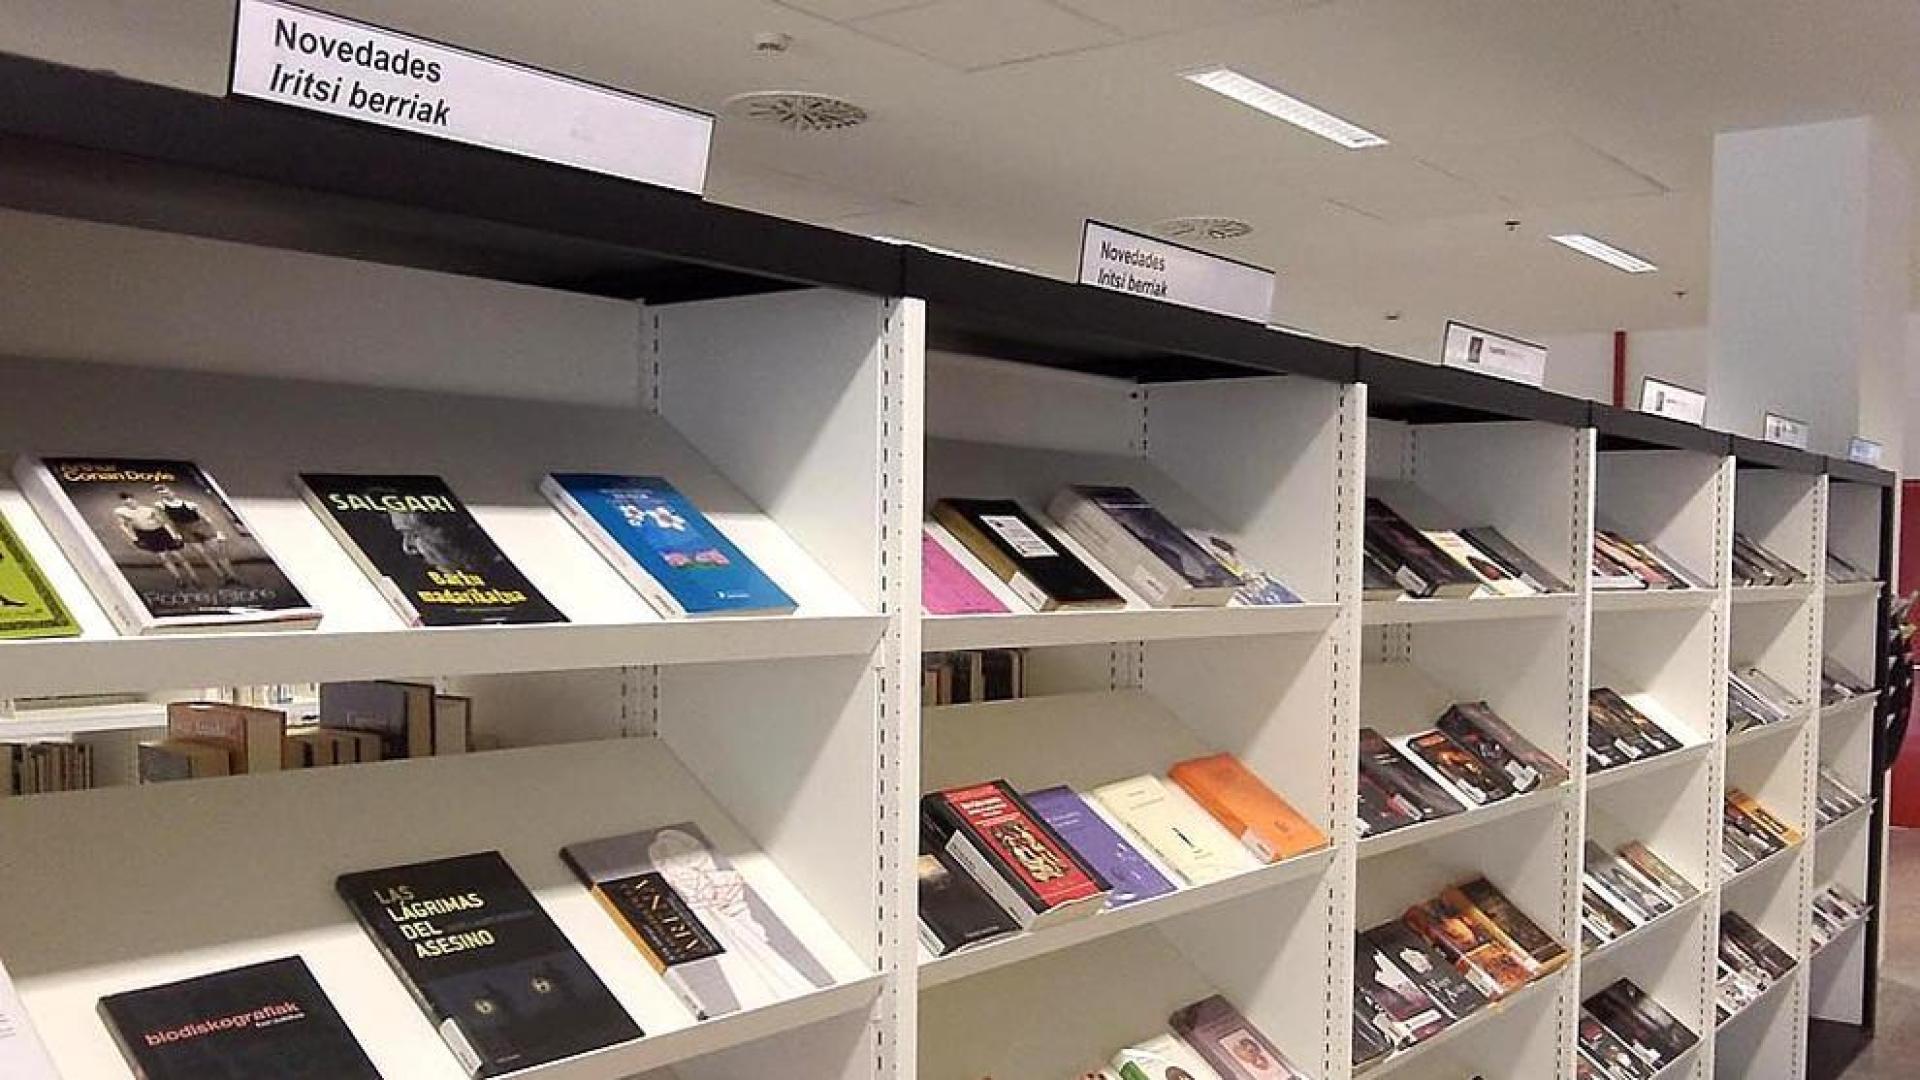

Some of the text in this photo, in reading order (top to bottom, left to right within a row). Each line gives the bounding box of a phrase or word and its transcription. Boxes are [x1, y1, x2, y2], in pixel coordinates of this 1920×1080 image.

[274, 18, 442, 83] Novedades
[269, 63, 451, 127] Iritsi berriak
[1101, 241, 1165, 272] Novedades
[1098, 268, 1168, 297] Iritsi berriak
[328, 493, 457, 513] SALGARI
[373, 885, 415, 904] LAS
[387, 892, 485, 923] LÁGRIMAS
[400, 920, 443, 941] DEL
[414, 929, 496, 959] ASESINO
[145, 1001, 300, 1046] biodiskografiak
